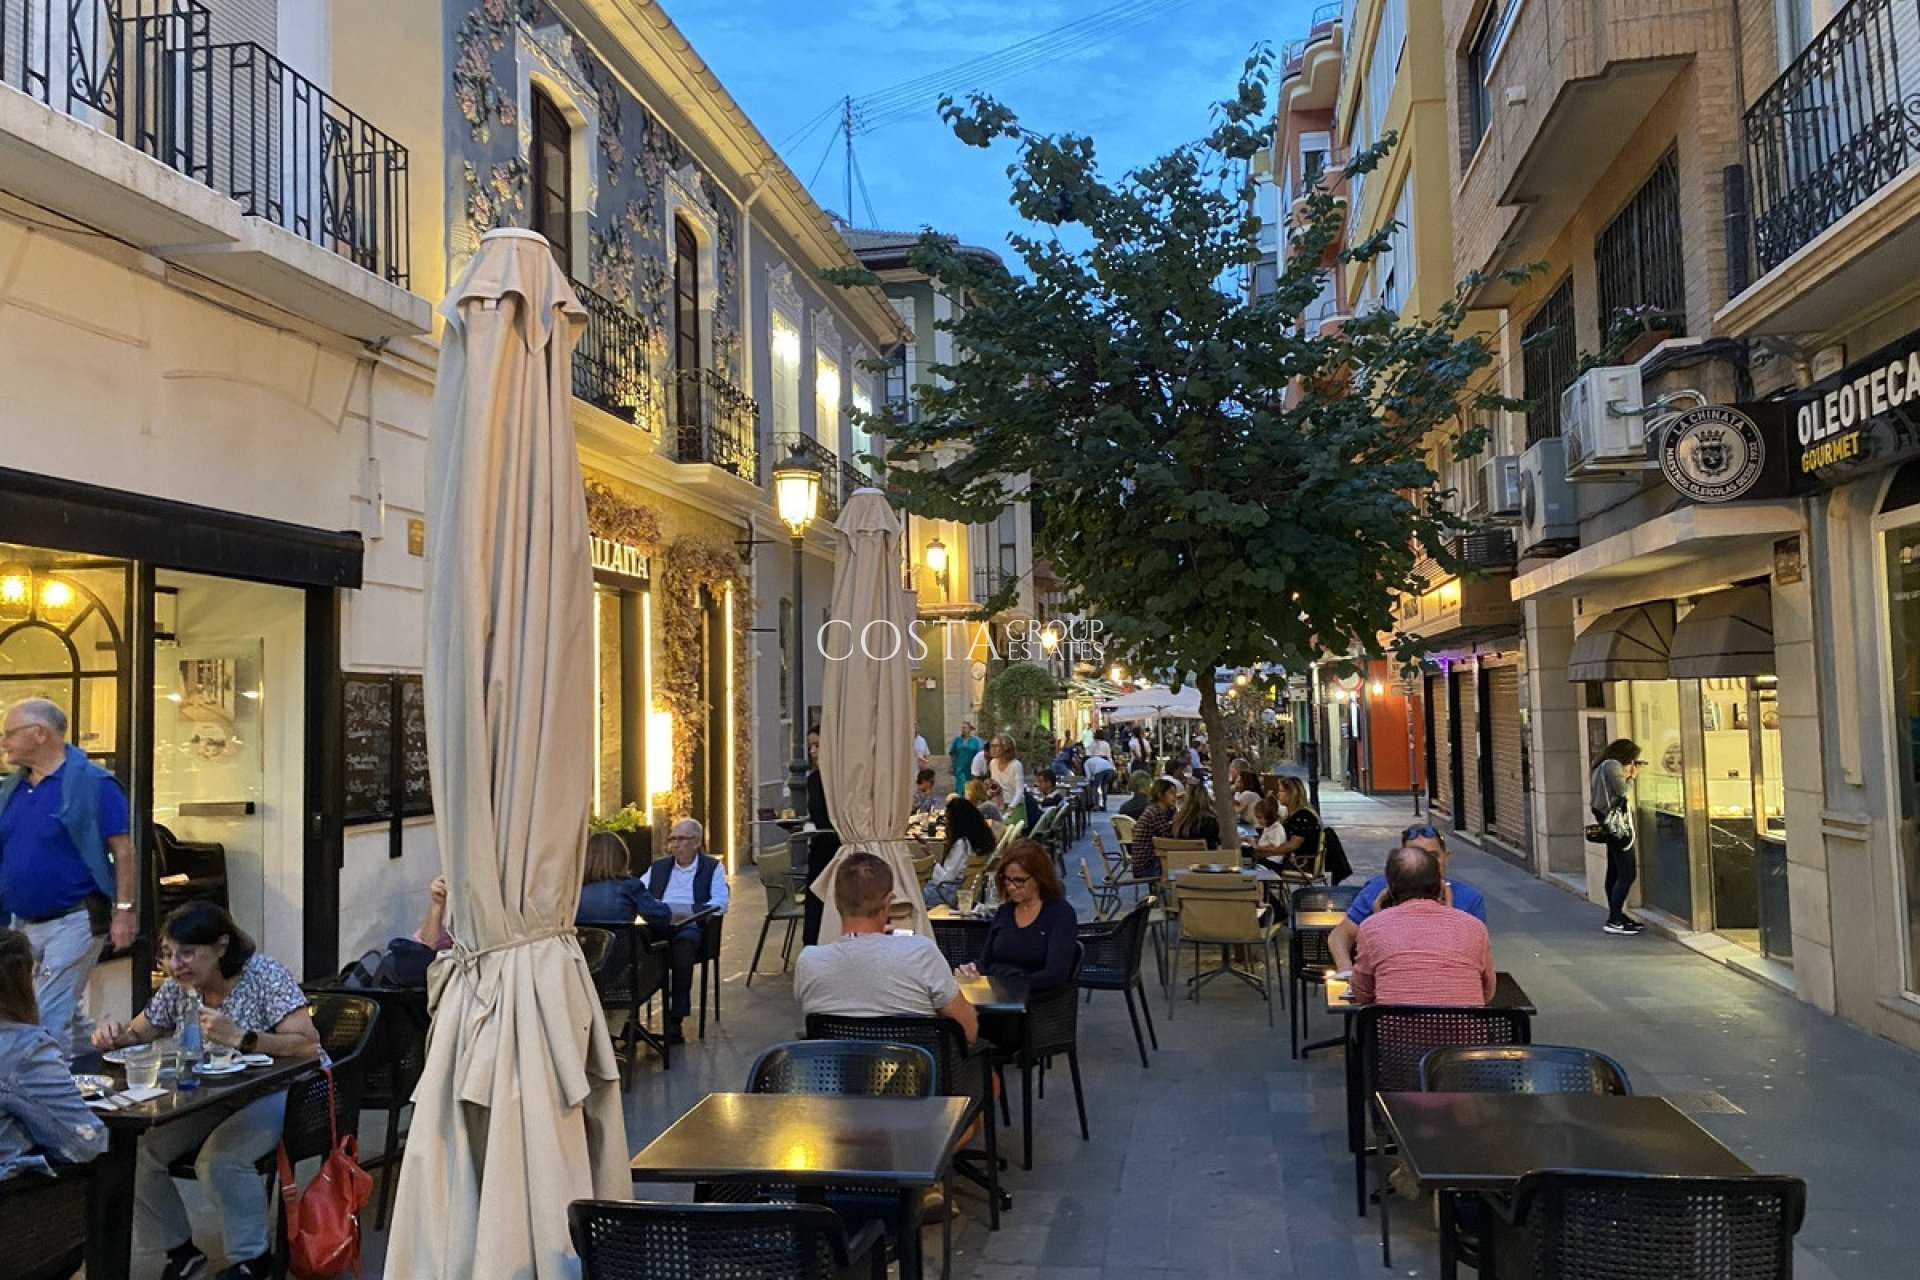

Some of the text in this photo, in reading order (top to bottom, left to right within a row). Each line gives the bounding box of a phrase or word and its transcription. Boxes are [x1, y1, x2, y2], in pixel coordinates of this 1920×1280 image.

[1798, 352, 1920, 445] OLEOTECA
[1673, 410, 1745, 436] LA CHINATA
[1801, 431, 1860, 473] GOURMET
